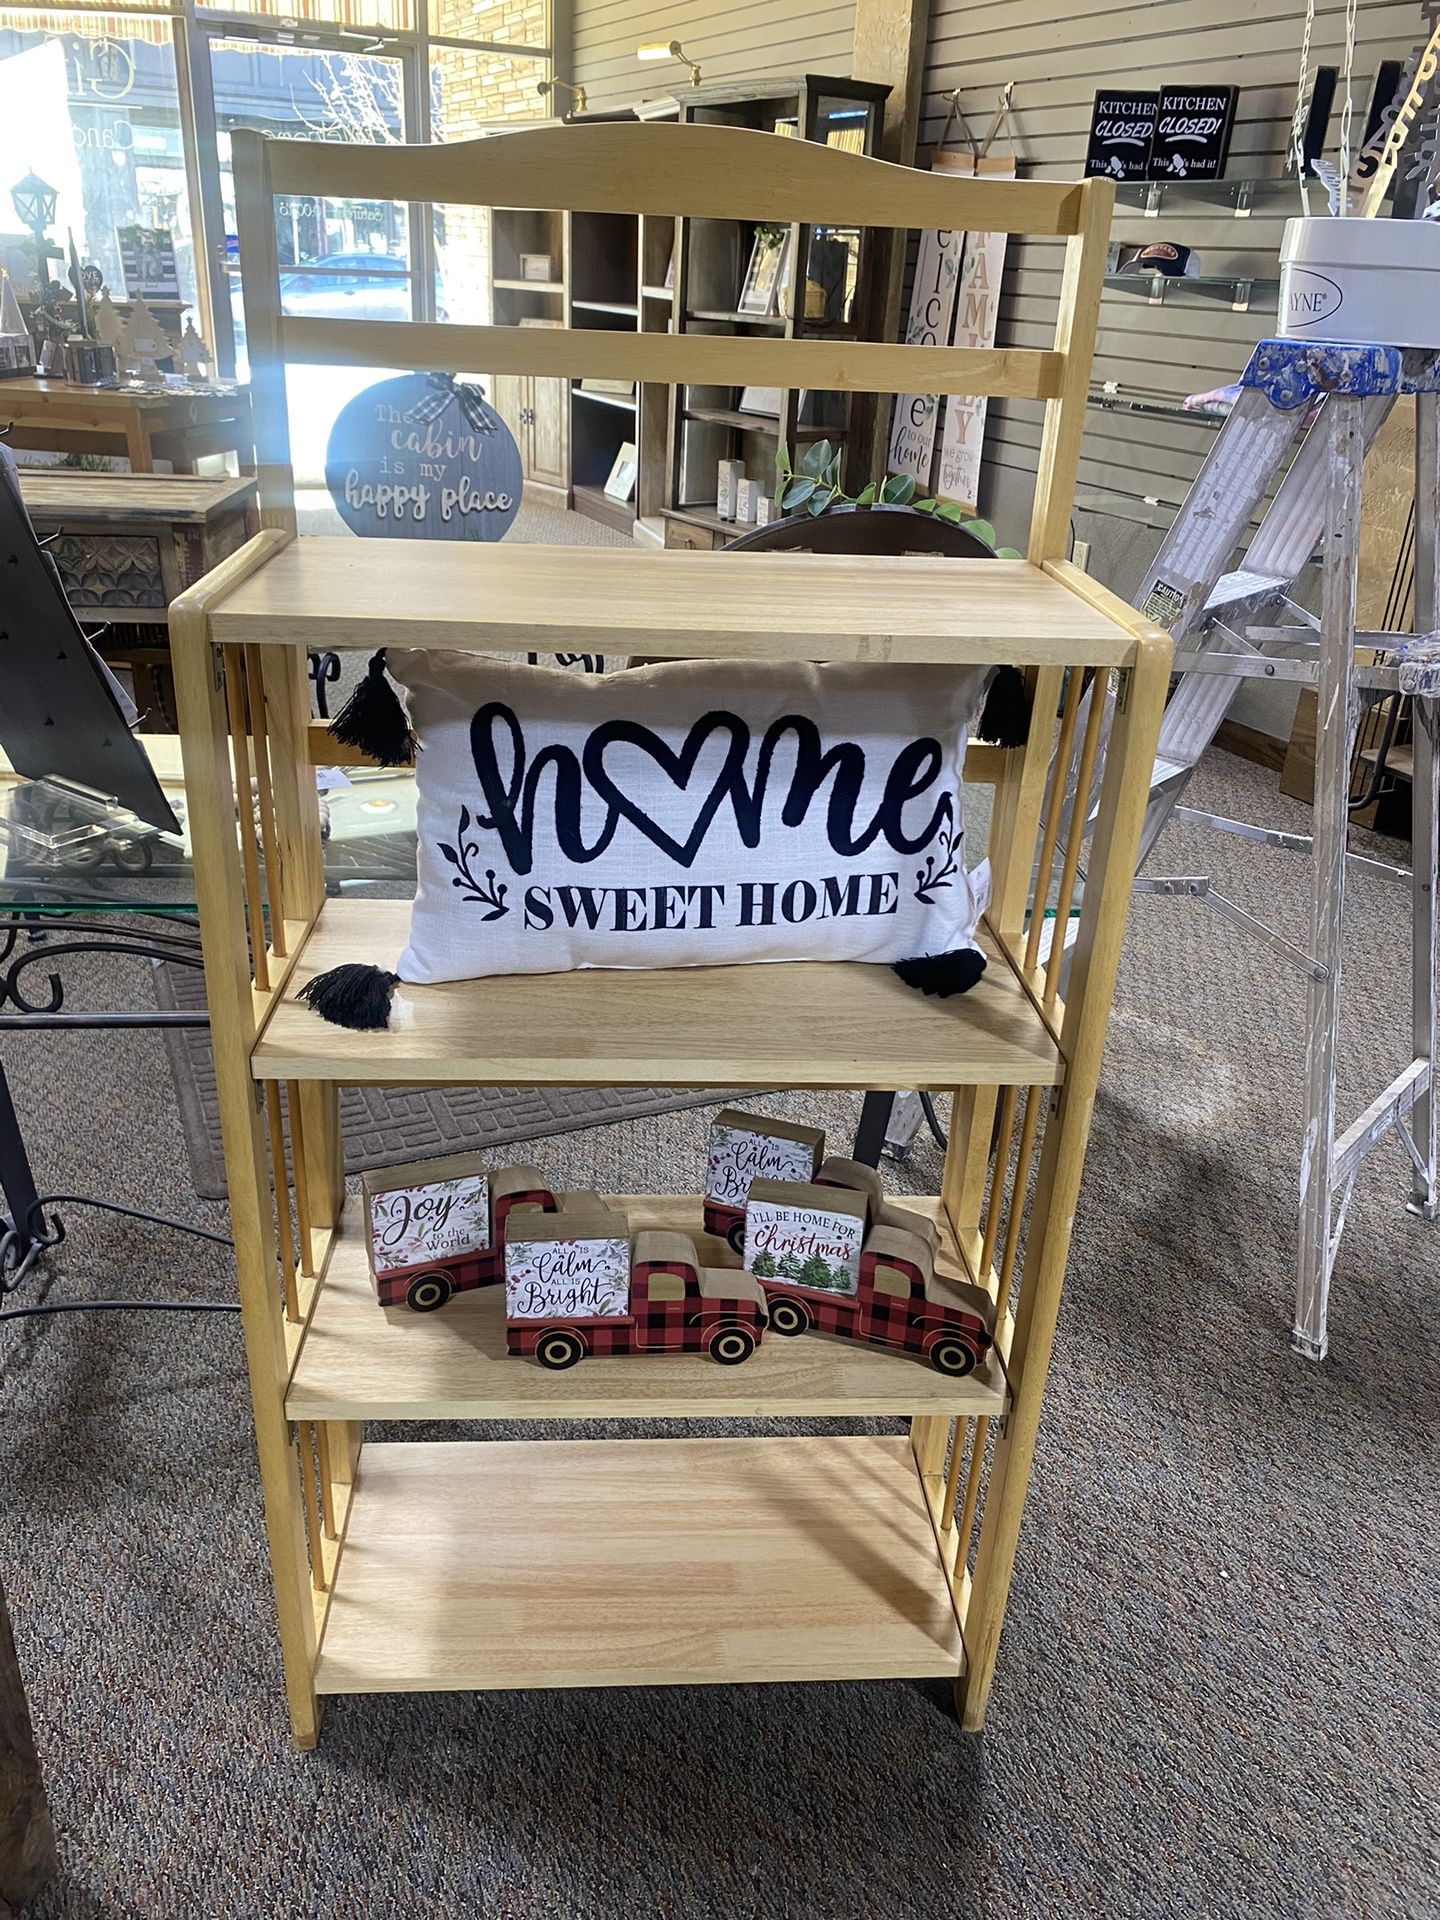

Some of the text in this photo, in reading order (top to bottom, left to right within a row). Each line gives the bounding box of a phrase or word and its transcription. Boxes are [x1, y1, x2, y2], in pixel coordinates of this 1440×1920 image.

[1162, 96, 1227, 111] KITCHEN
[1159, 116, 1223, 135] CLOSED!
[1090, 159, 1107, 169] This
[1128, 161, 1144, 171] had
[1152, 157, 1170, 167] This
[1191, 159, 1206, 168] had
[1207, 159, 1216, 168] it!
[374, 403, 414, 424] The
[390, 418, 483, 463] cabin
[889, 426, 930, 474] home
[907, 429, 932, 448] to our
[379, 456, 447, 482] is my
[345, 468, 513, 521] happy place
[524, 872, 899, 932] SWEET HOME
[731, 1141, 794, 1171] Calm
[748, 1138, 780, 1152] ALL IS
[382, 1195, 460, 1246] Joy
[752, 1211, 773, 1223] I'LL
[776, 1211, 790, 1221] BE
[794, 1212, 830, 1228] HOME
[831, 1221, 856, 1240] FOR
[425, 1233, 471, 1251] World
[433, 1227, 465, 1241] to the
[580, 1246, 589, 1254] IS
[532, 1250, 607, 1284] Calm
[517, 1277, 615, 1313] Bright
